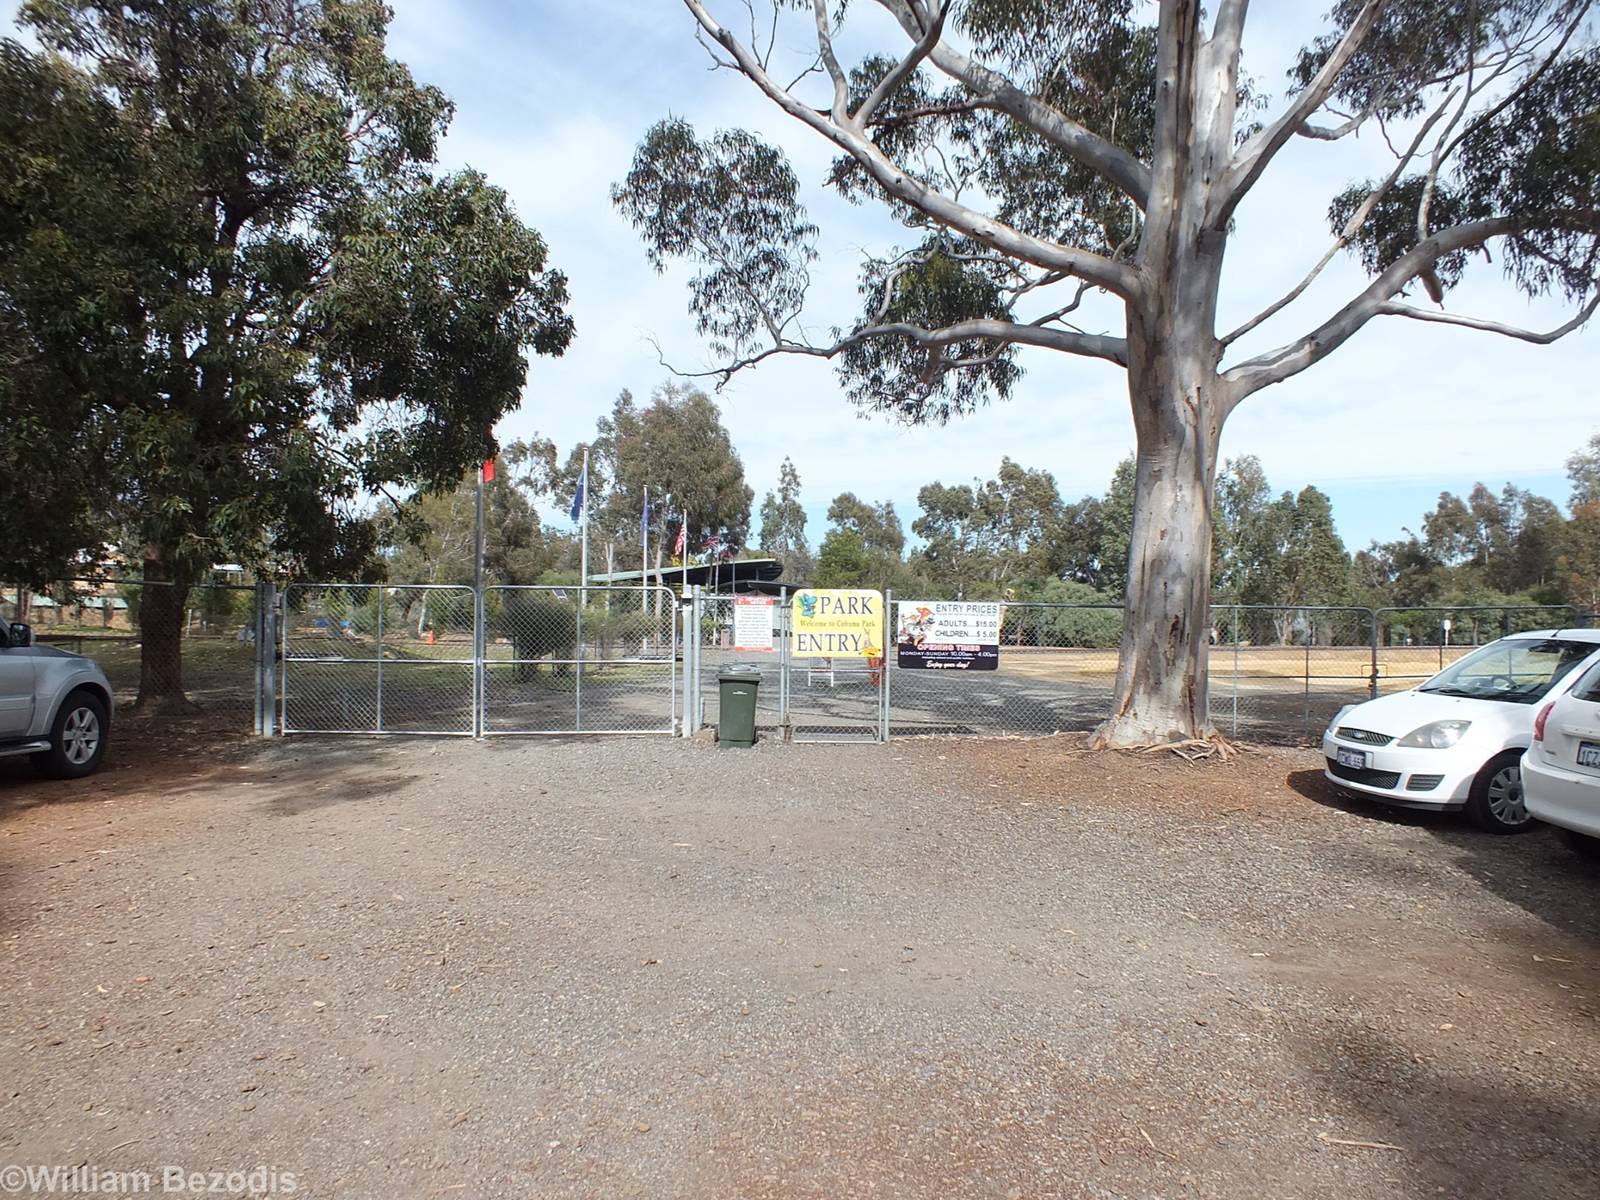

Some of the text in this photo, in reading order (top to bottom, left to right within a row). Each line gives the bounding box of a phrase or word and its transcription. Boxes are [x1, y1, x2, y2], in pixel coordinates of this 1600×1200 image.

[820, 596, 873, 615] PARK
[936, 604, 997, 613] ENTRY PRICES
[800, 620, 827, 628] Welcome
[829, 620, 835, 628] to
[862, 620, 876, 628] Park
[976, 620, 997, 628] $15.00
[935, 630, 968, 638] CHILDREN
[797, 633, 862, 652] ENTRY
